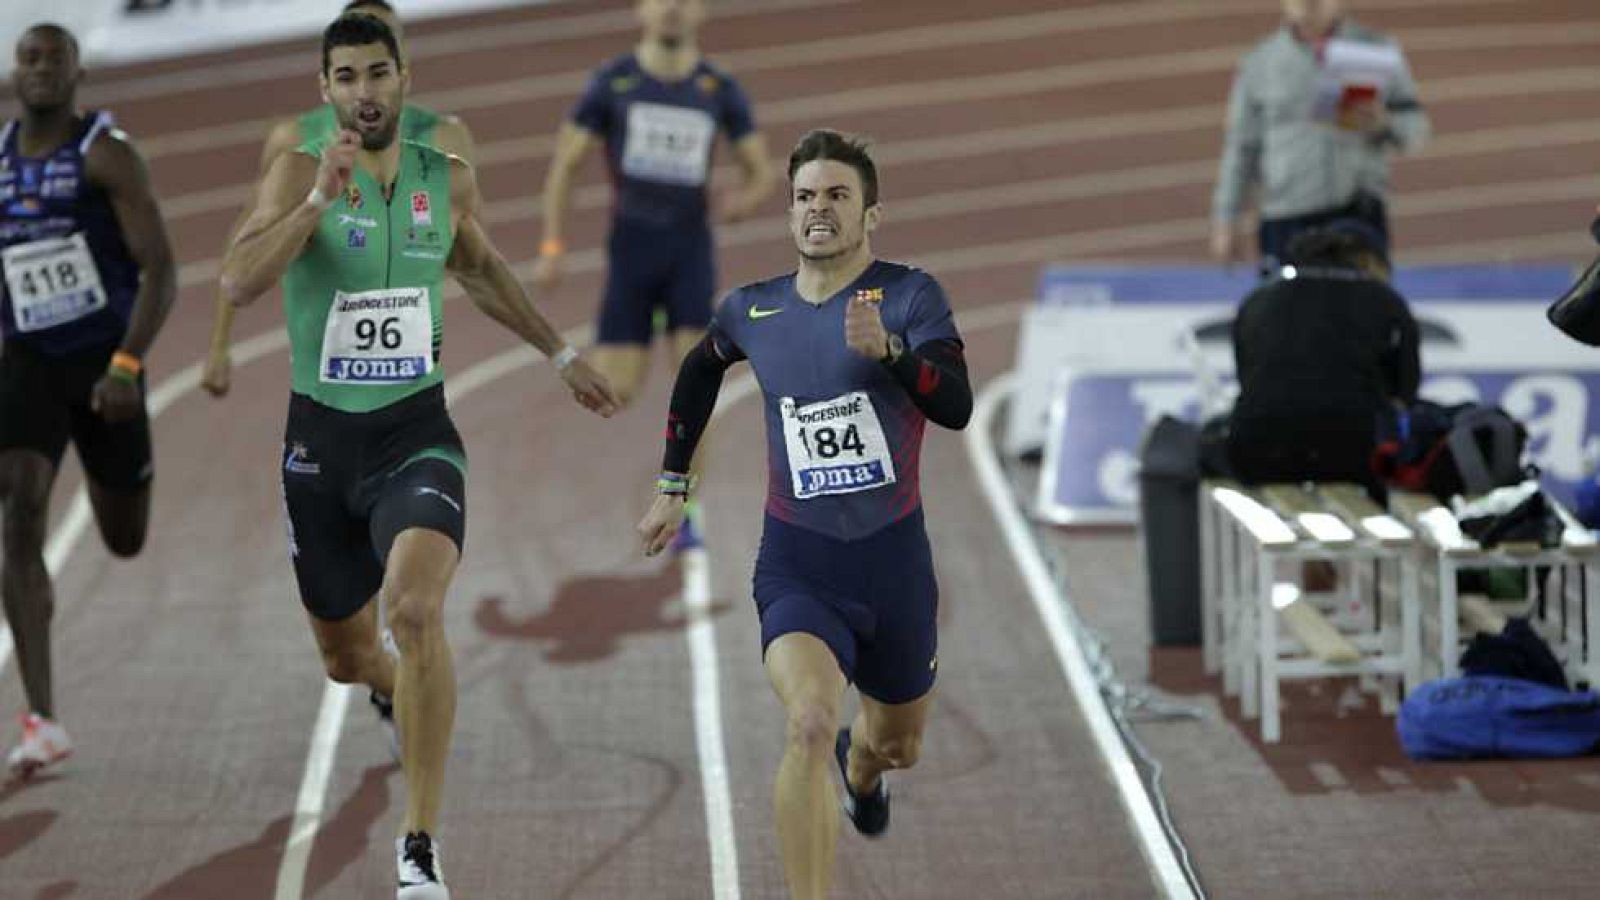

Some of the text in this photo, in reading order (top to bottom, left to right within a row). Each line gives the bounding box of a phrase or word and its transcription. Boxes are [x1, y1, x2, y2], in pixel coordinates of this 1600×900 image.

[22, 262, 79, 297] 418
[355, 317, 402, 350] 96
[798, 424, 865, 459] 184
